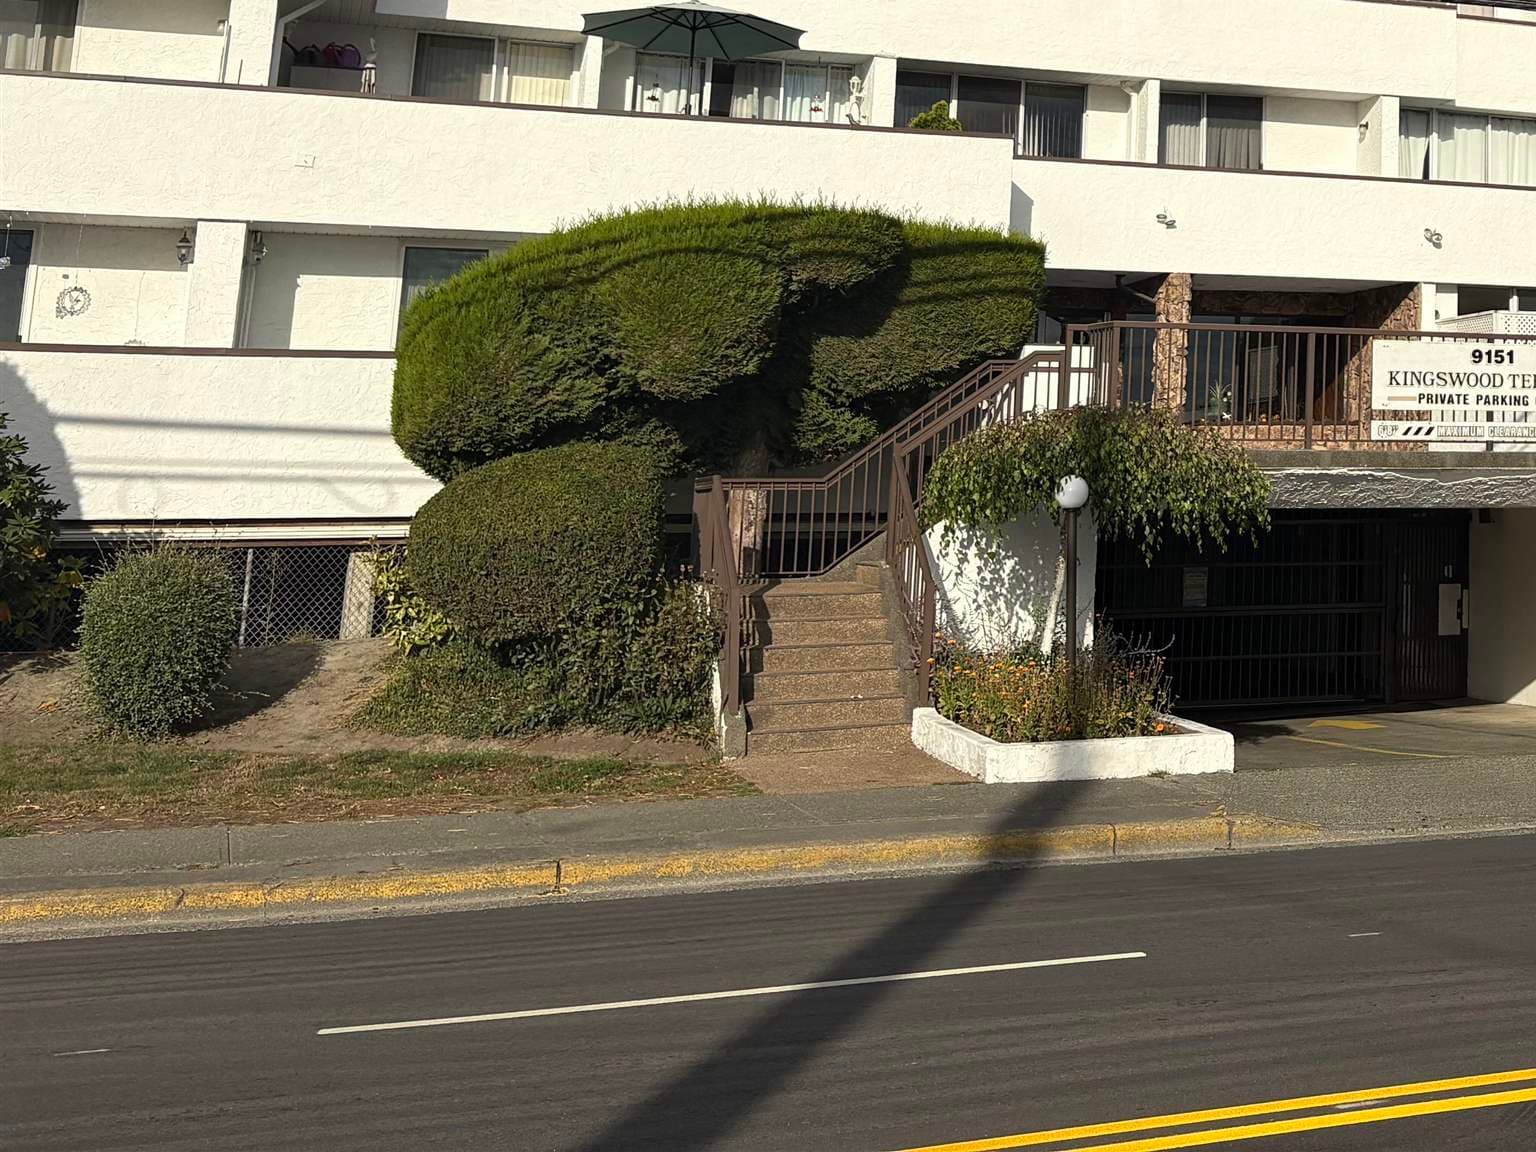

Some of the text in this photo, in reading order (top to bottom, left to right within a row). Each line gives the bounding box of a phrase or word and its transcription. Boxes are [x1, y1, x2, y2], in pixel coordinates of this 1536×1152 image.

[1471, 349, 1514, 364] 9151
[1388, 371, 1504, 388] KINGSWOOD
[1418, 393, 1470, 405] PRIVATE
[1476, 394, 1529, 406] PARKING
[1437, 425, 1484, 437] MAXIMUM
